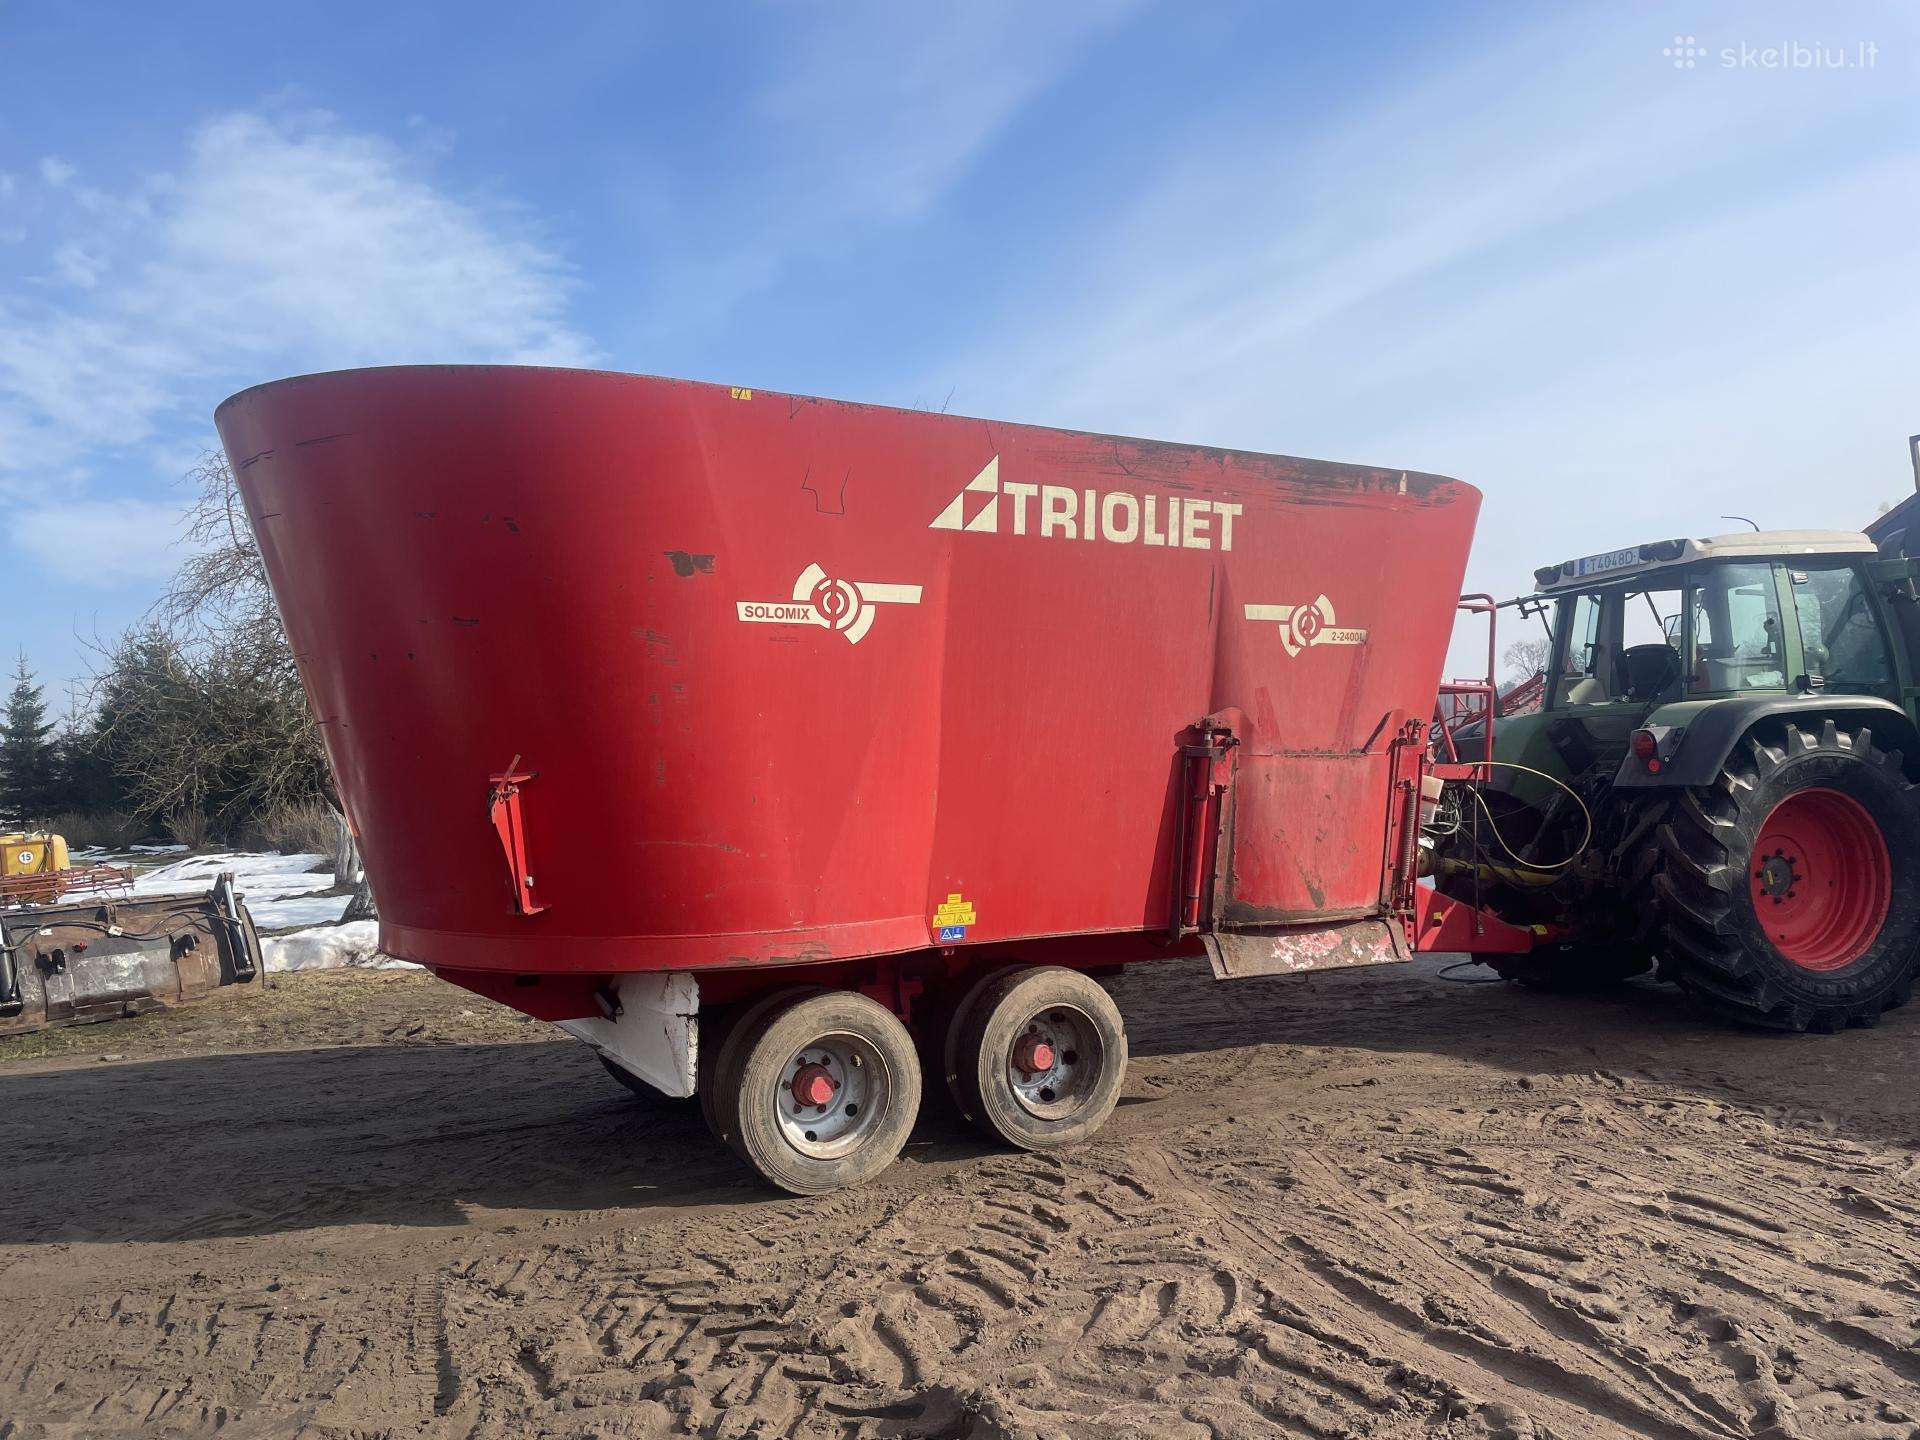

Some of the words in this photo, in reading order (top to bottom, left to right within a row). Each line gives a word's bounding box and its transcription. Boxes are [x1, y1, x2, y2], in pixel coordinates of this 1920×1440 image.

[1003, 481, 1243, 551] TRIOLIET
[744, 605, 810, 620] SOLOMIX
[21, 853, 31, 861] 15
